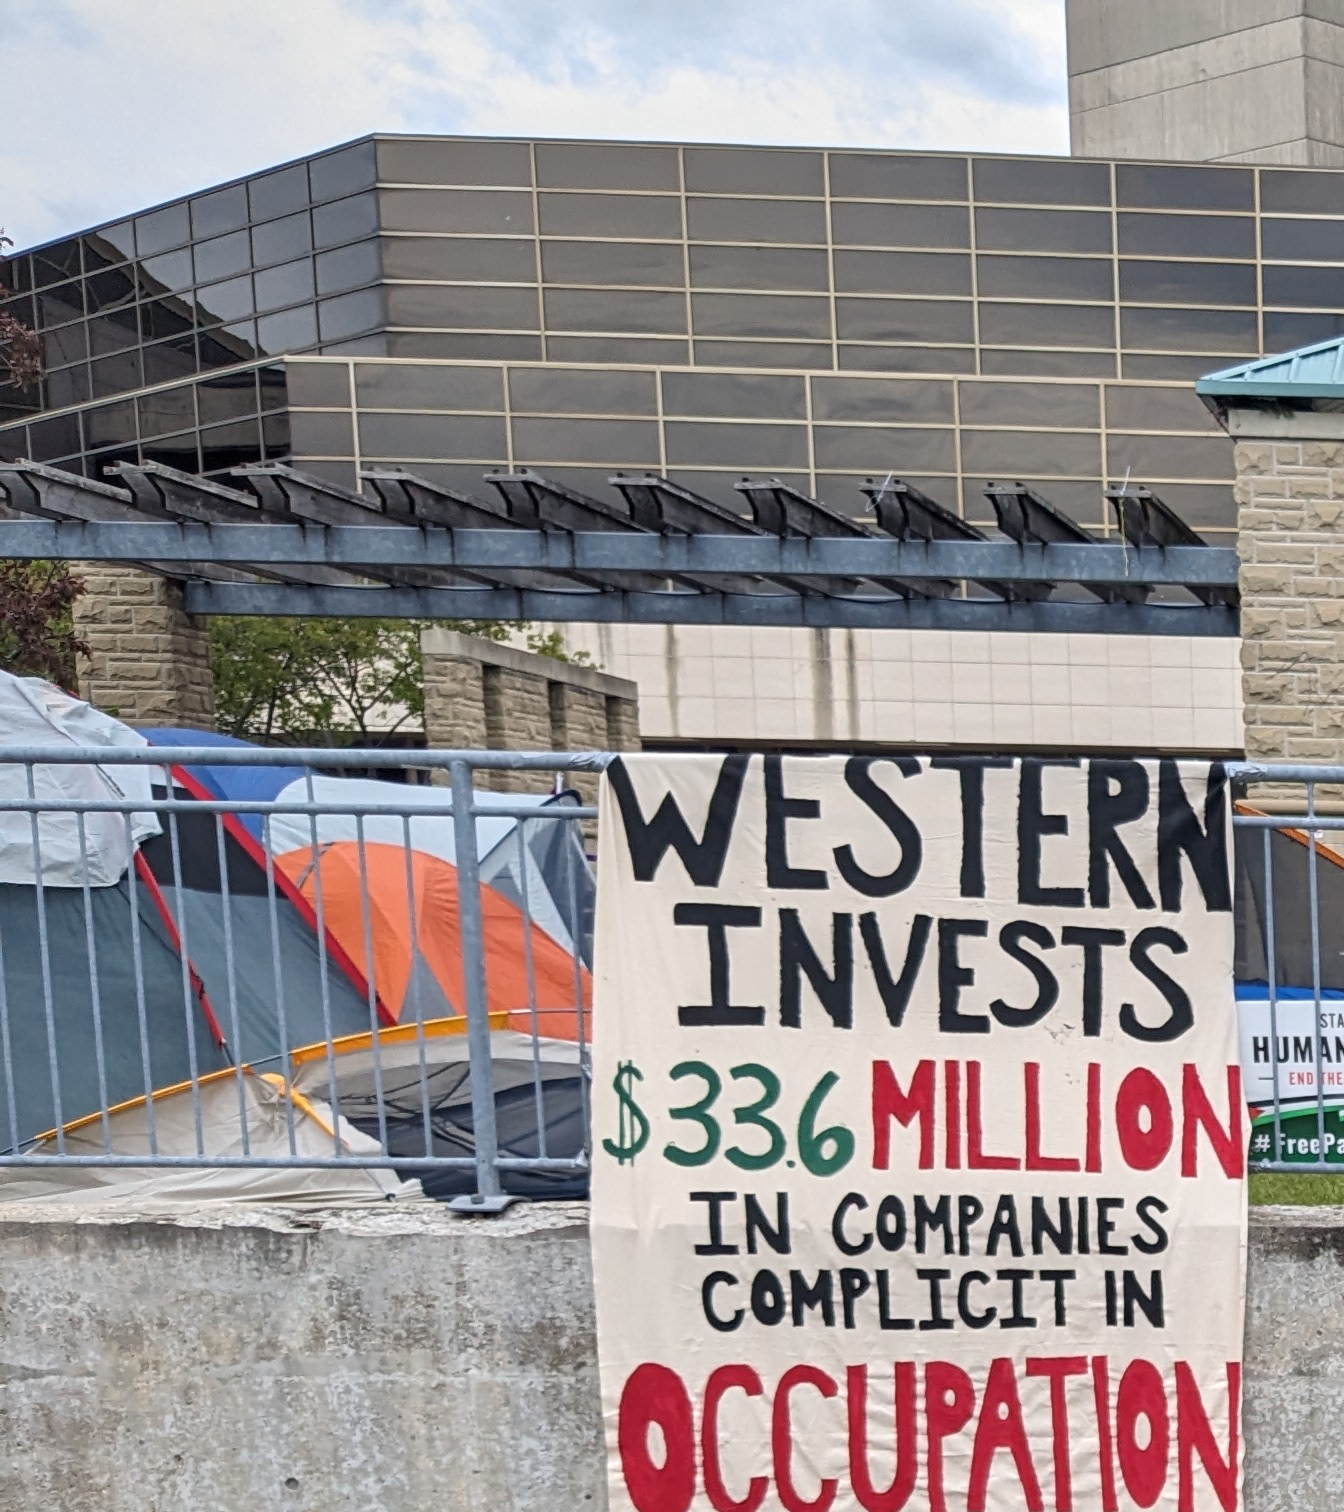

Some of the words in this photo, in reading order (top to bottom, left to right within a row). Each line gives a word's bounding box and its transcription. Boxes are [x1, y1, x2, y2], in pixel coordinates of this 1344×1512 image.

[606, 752, 1233, 912] WESTERN
[673, 902, 1195, 1042] INVESTS
[602, 1060, 855, 1177] $33.6
[872, 1060, 1244, 1179] MILLION
[1288, 1071, 1314, 1086] END
[1320, 1071, 1344, 1085] THE
[690, 1191, 791, 1256] IN
[832, 1193, 1168, 1257] COMPANIES
[702, 1268, 1075, 1331] COMPLICIT
[1105, 1270, 1165, 1328] IN
